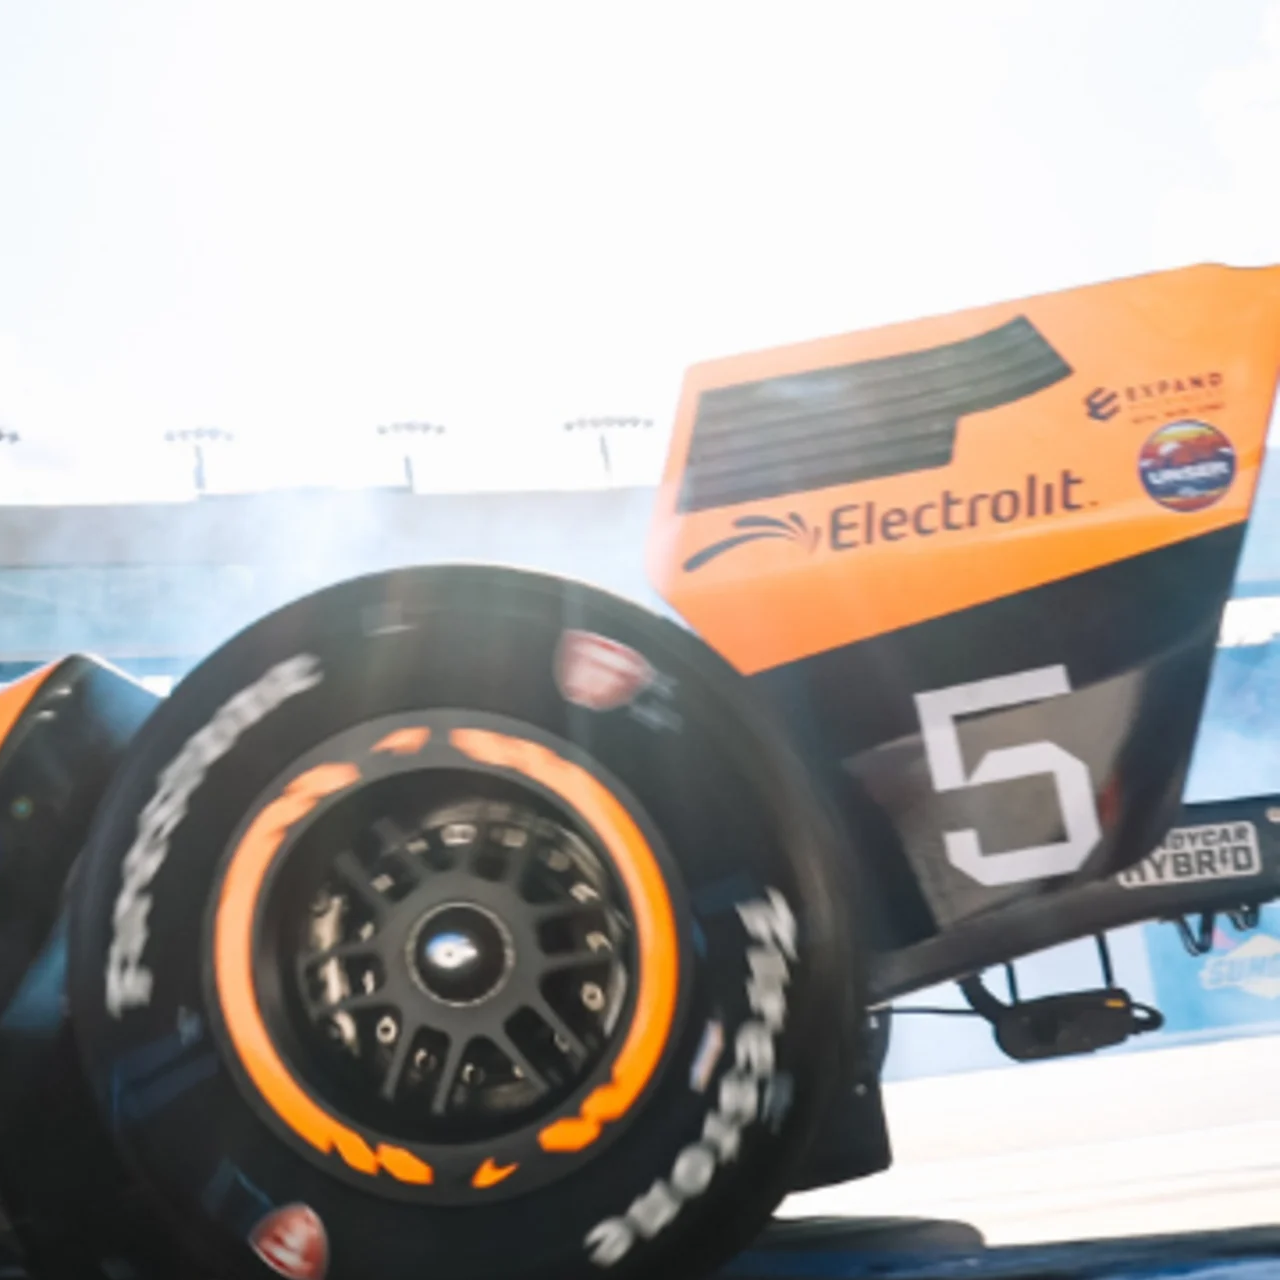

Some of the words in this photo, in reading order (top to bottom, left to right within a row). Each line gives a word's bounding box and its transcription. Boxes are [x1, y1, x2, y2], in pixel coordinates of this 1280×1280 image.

[1126, 372, 1223, 402] EXPAND
[829, 470, 1084, 551] Electrolit
[913, 664, 1103, 886] 5
